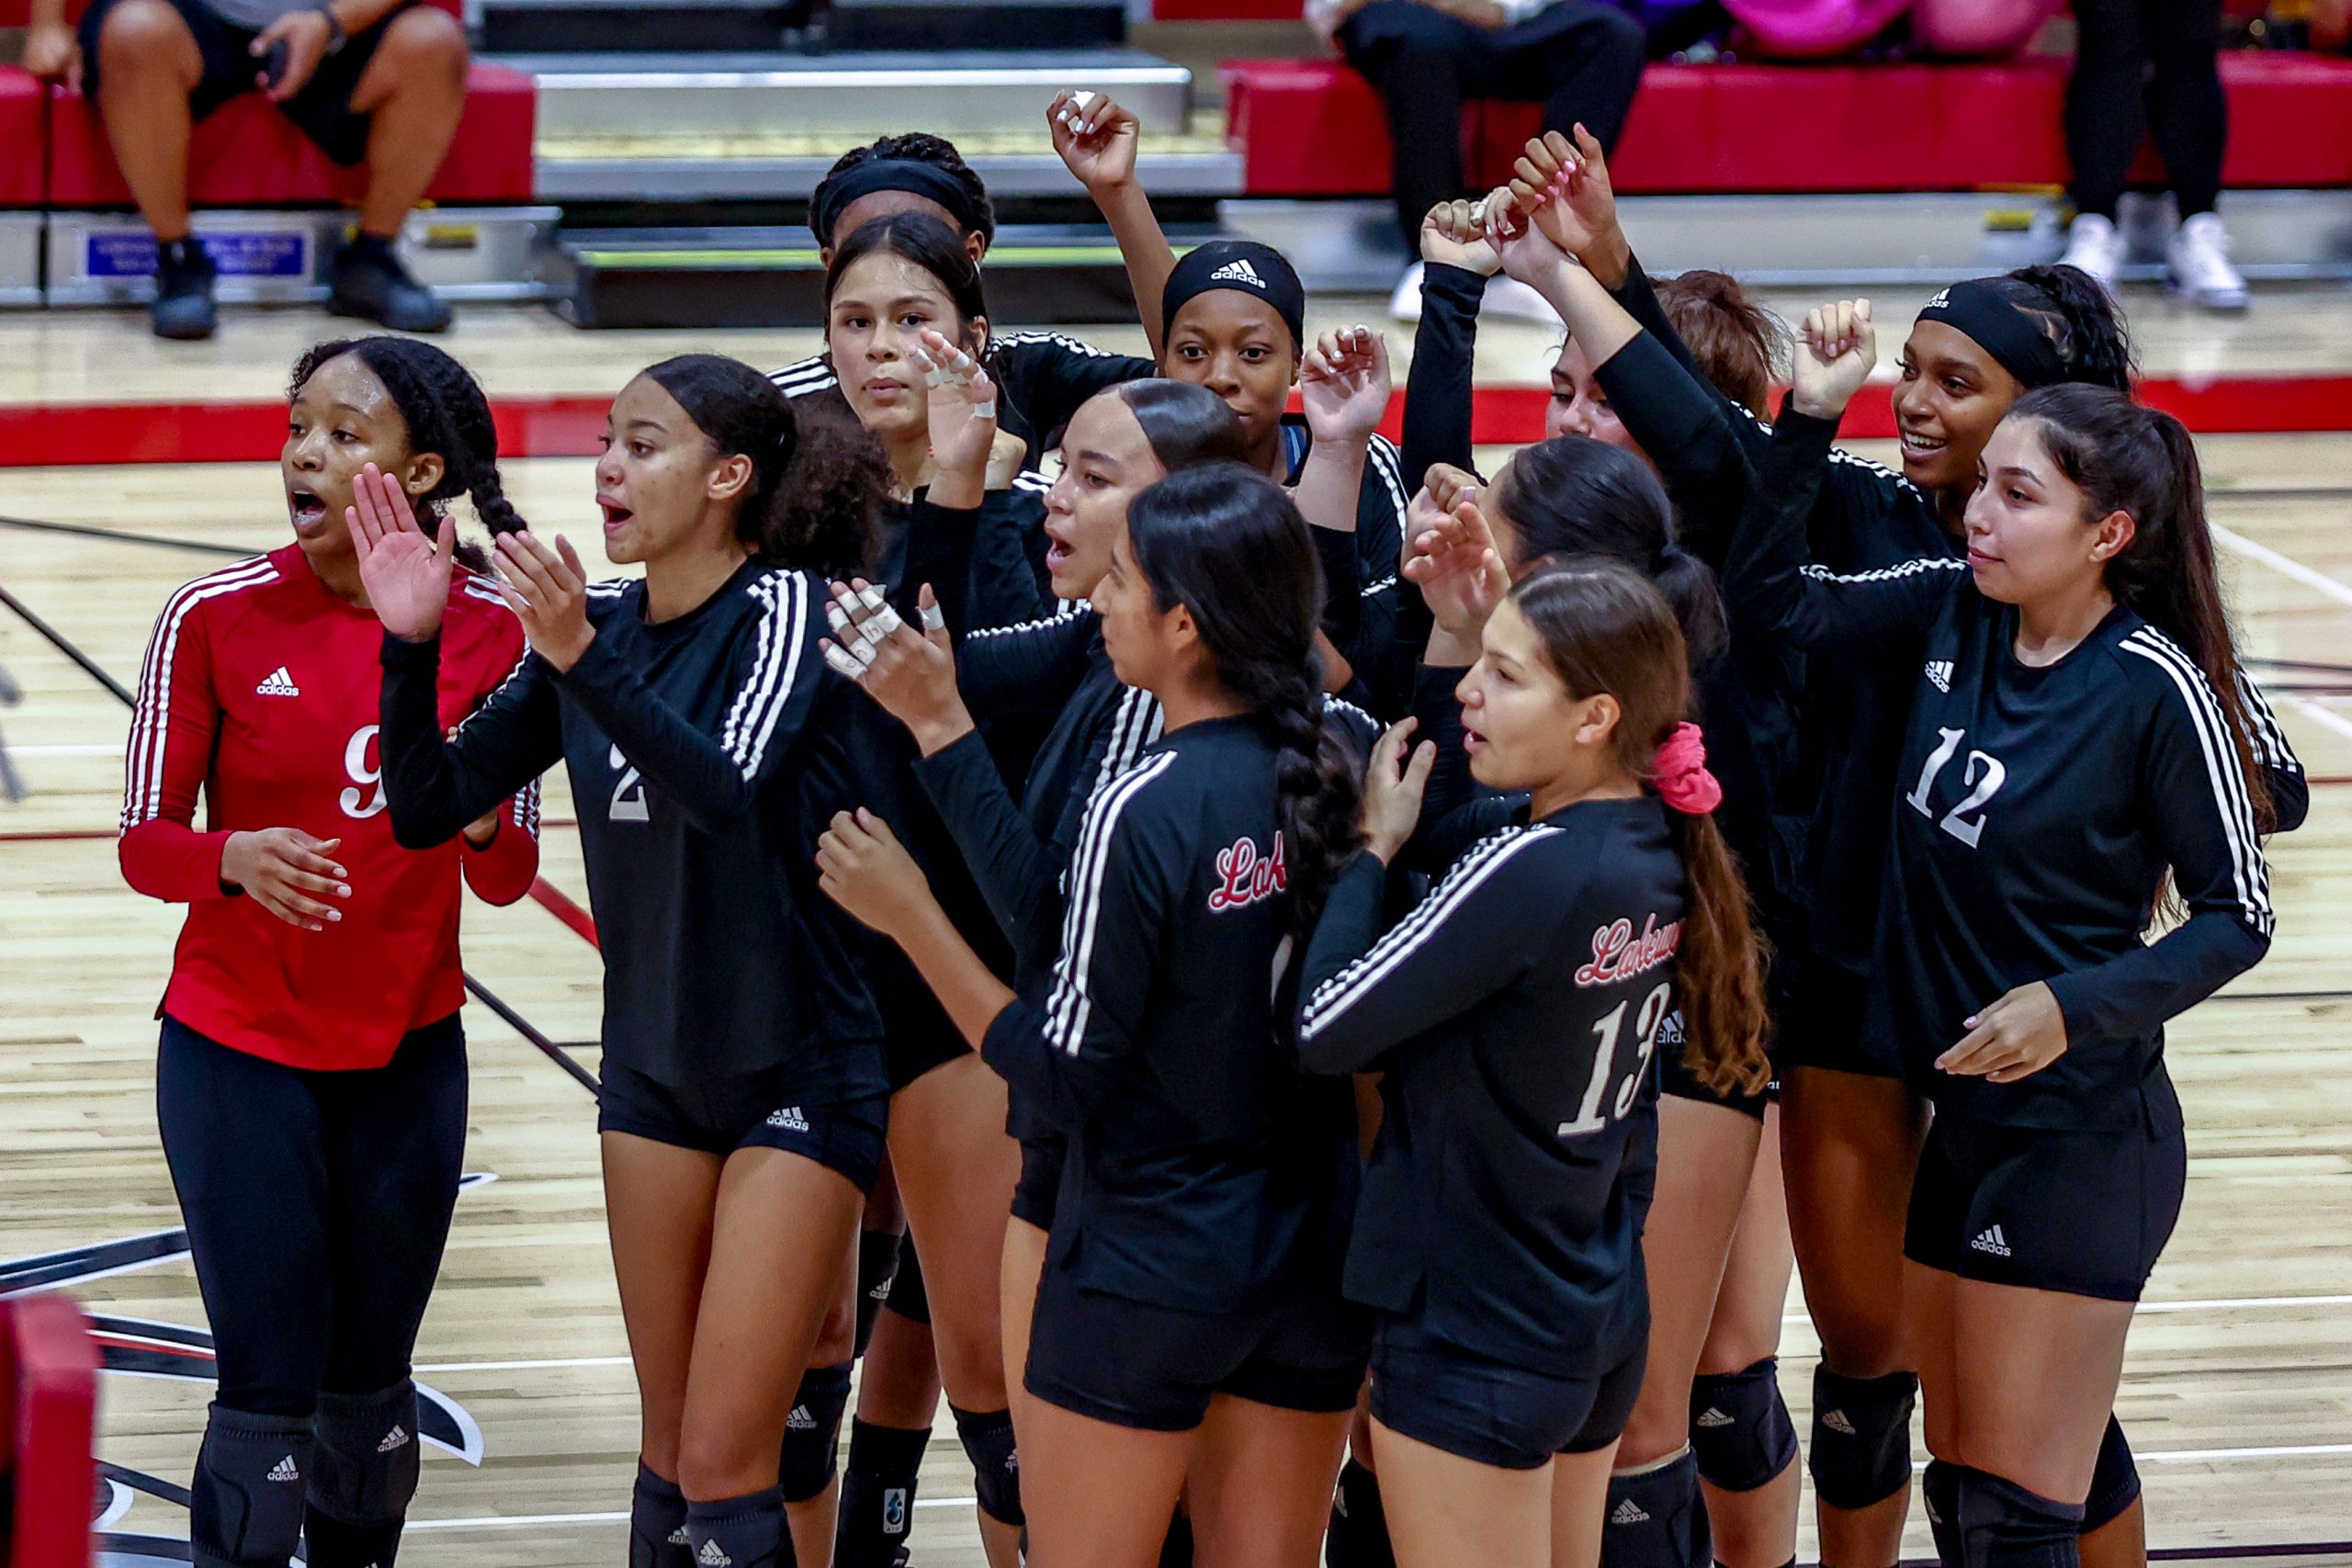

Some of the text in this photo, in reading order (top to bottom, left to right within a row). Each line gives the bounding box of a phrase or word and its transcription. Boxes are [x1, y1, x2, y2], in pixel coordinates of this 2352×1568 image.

[1210, 270, 1267, 289] adidas
[256, 684, 300, 697] adidas
[339, 724, 388, 818] 9
[608, 742, 650, 822] 2
[1906, 726, 2006, 851] 12
[1208, 830, 1286, 911] Lak
[1557, 981, 1672, 1136] 13
[766, 1114, 809, 1131] adidas
[1971, 1239, 2011, 1258] adidas
[266, 1470, 300, 1481] adidas
